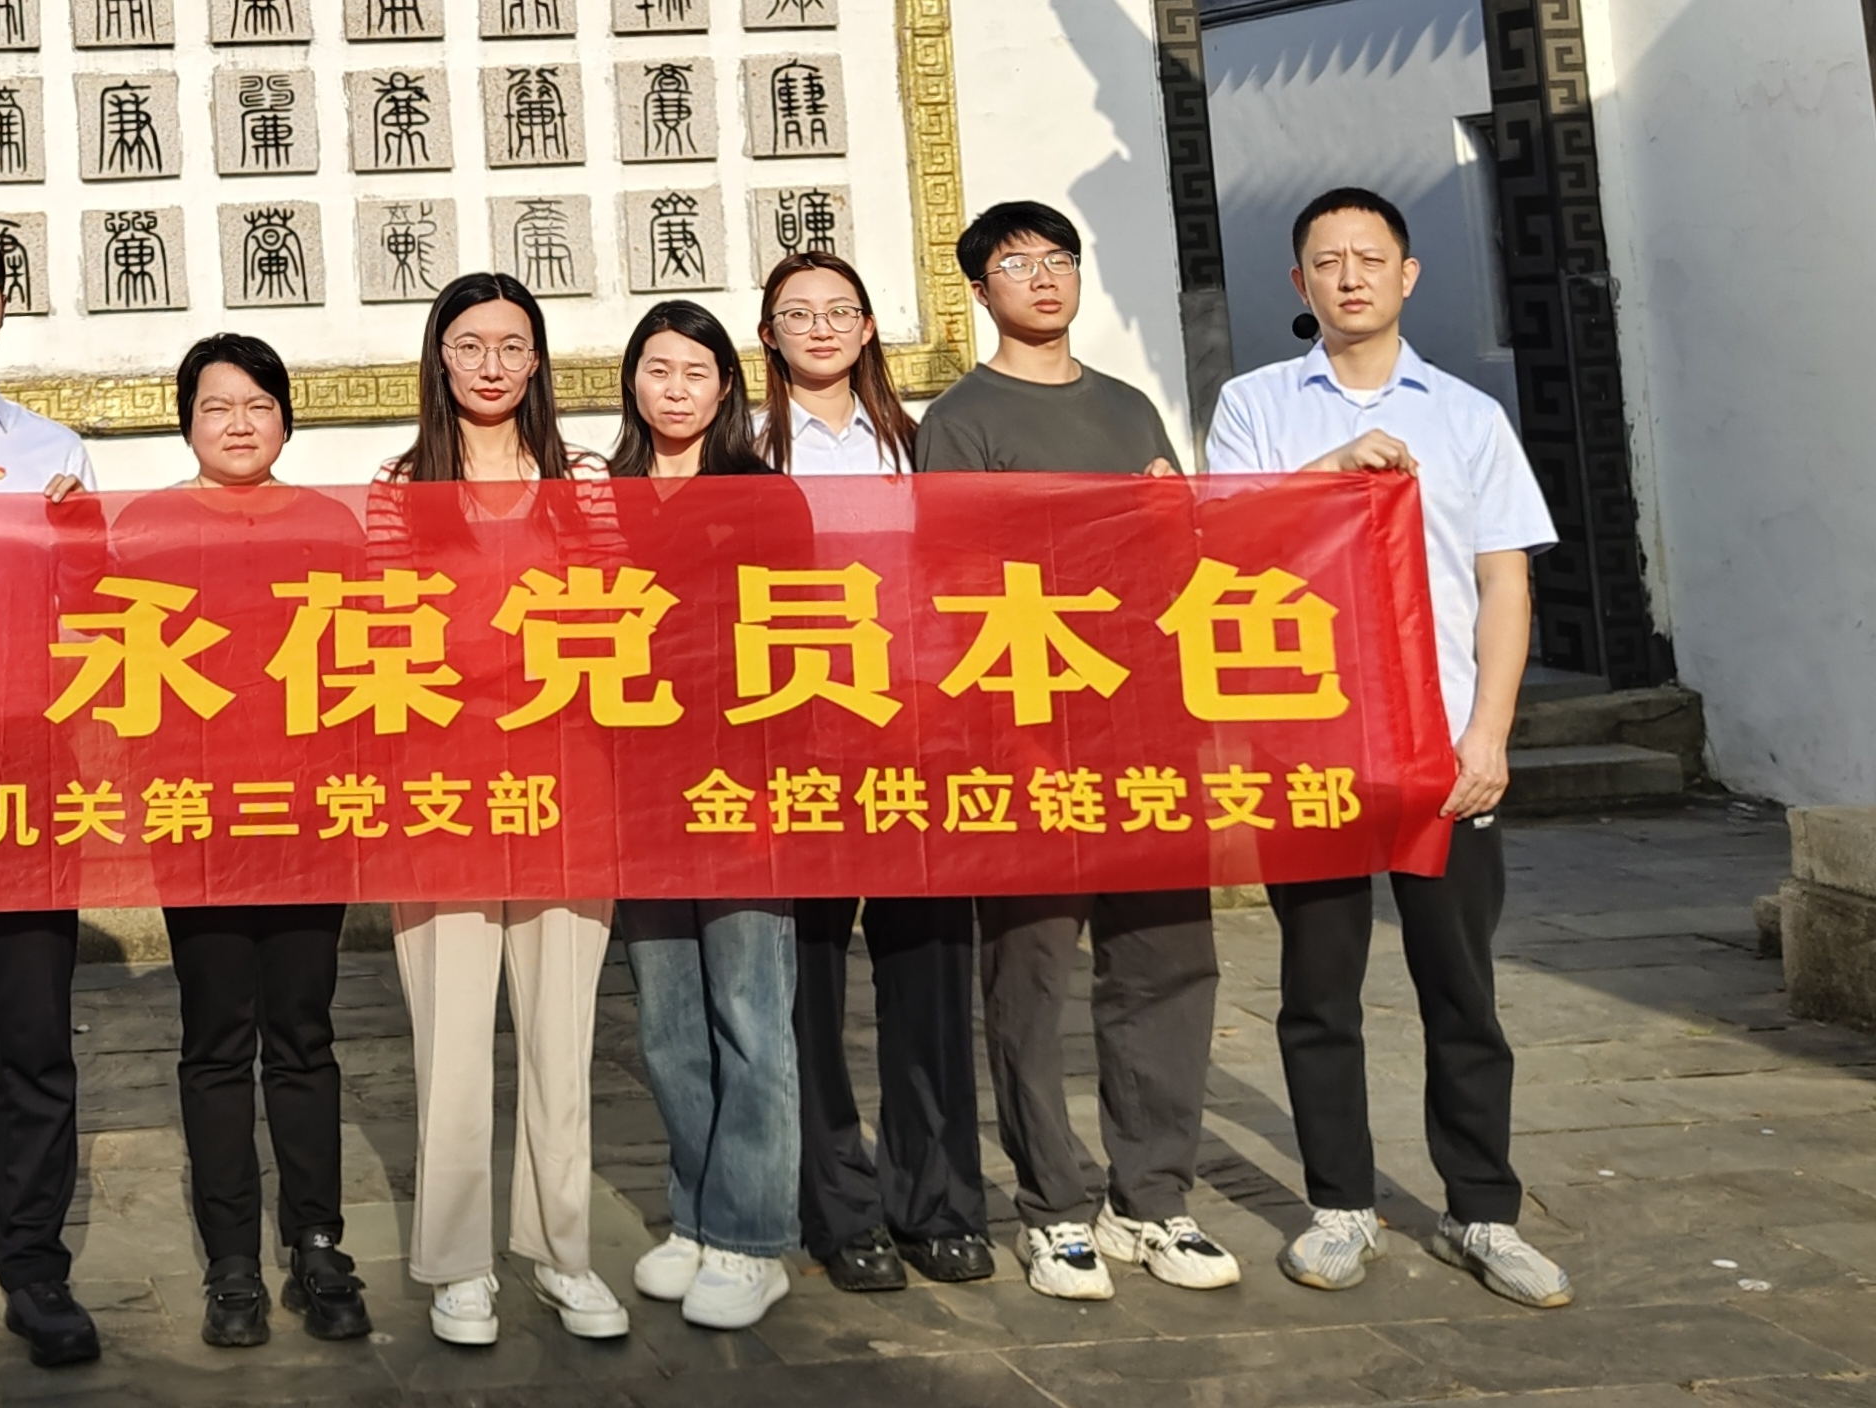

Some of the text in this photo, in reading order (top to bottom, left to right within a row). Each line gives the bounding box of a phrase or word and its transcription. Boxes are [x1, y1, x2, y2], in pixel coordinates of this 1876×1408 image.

[47, 559, 1350, 738] 永葆党员本色
[684, 764, 1362, 834] 金控供应链党支部
